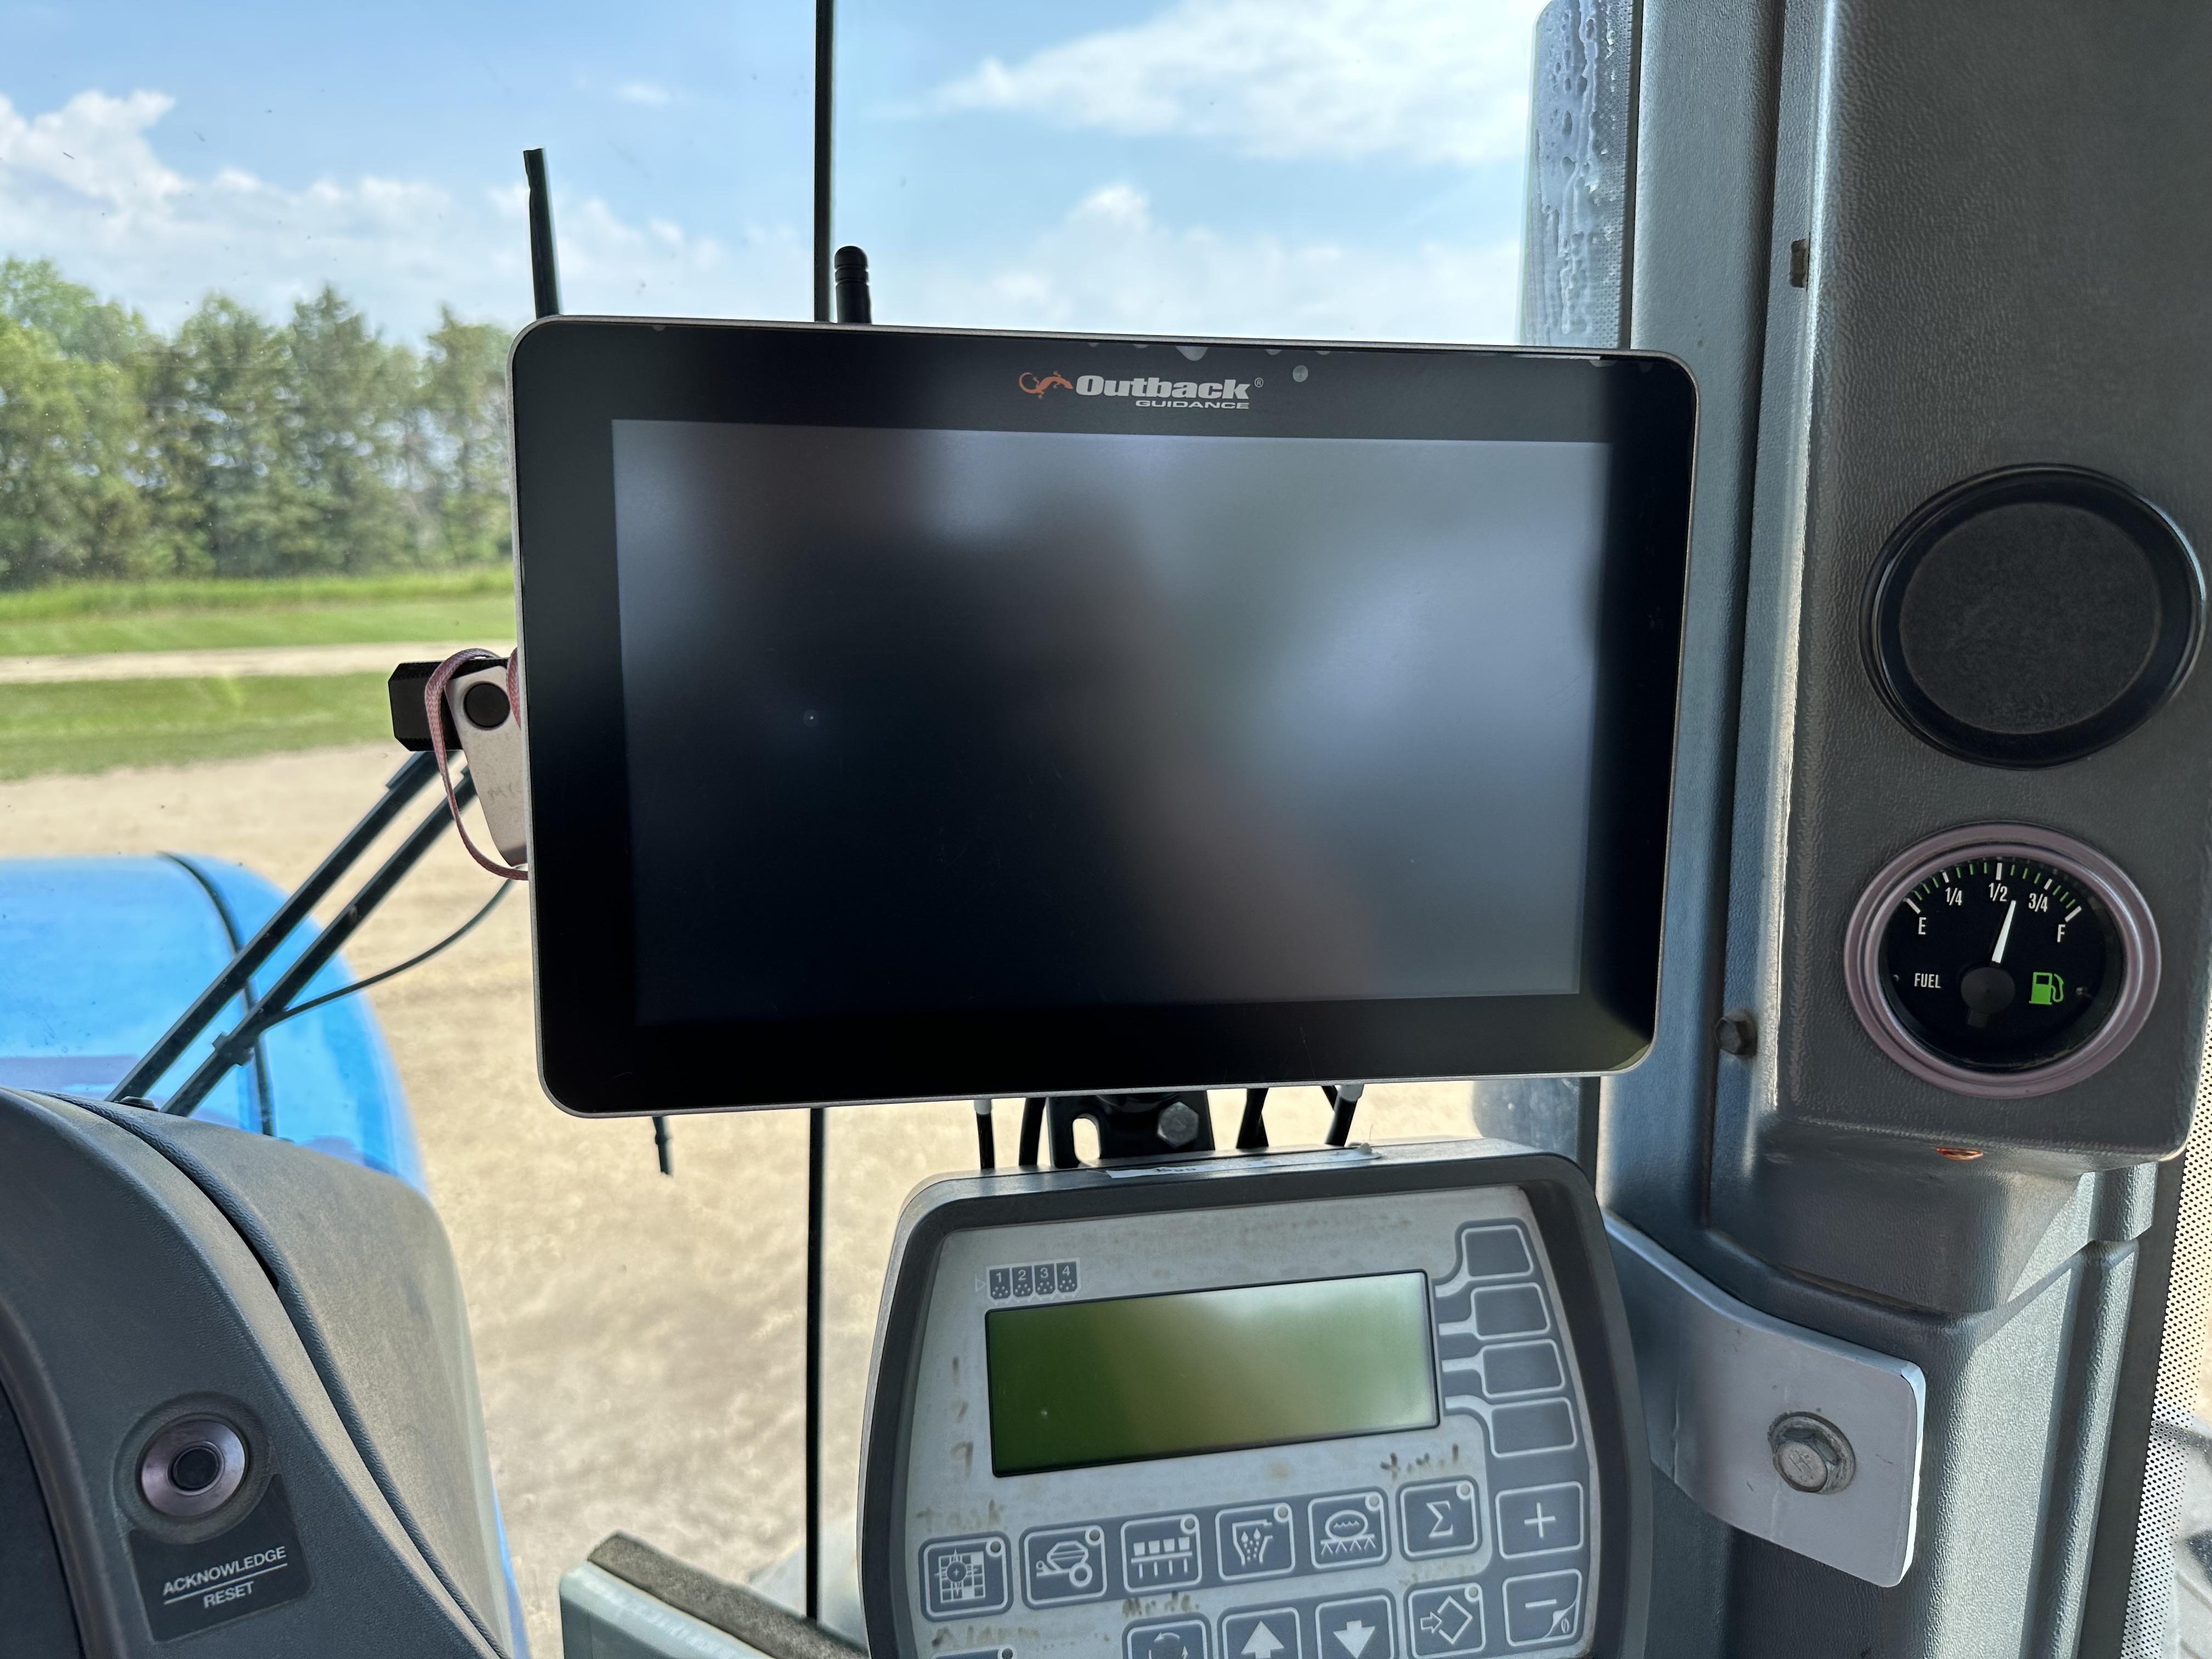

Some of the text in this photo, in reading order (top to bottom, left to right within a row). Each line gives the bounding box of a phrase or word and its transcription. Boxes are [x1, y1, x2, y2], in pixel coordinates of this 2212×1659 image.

[1135, 400, 1250, 409] GUIDANCE
[1945, 887, 1962, 906] 1/4
[1988, 883, 2007, 902] 1/2
[2029, 893, 2047, 912] 3/4
[1918, 917, 1926, 935] E
[2057, 924, 2066, 943] F
[1914, 973, 1941, 989] FUEL
[996, 1265, 1070, 1283] 1 2 3 4
[162, 1545, 286, 1596] ACKNOWLEDGE
[203, 1581, 254, 1609] RESET
